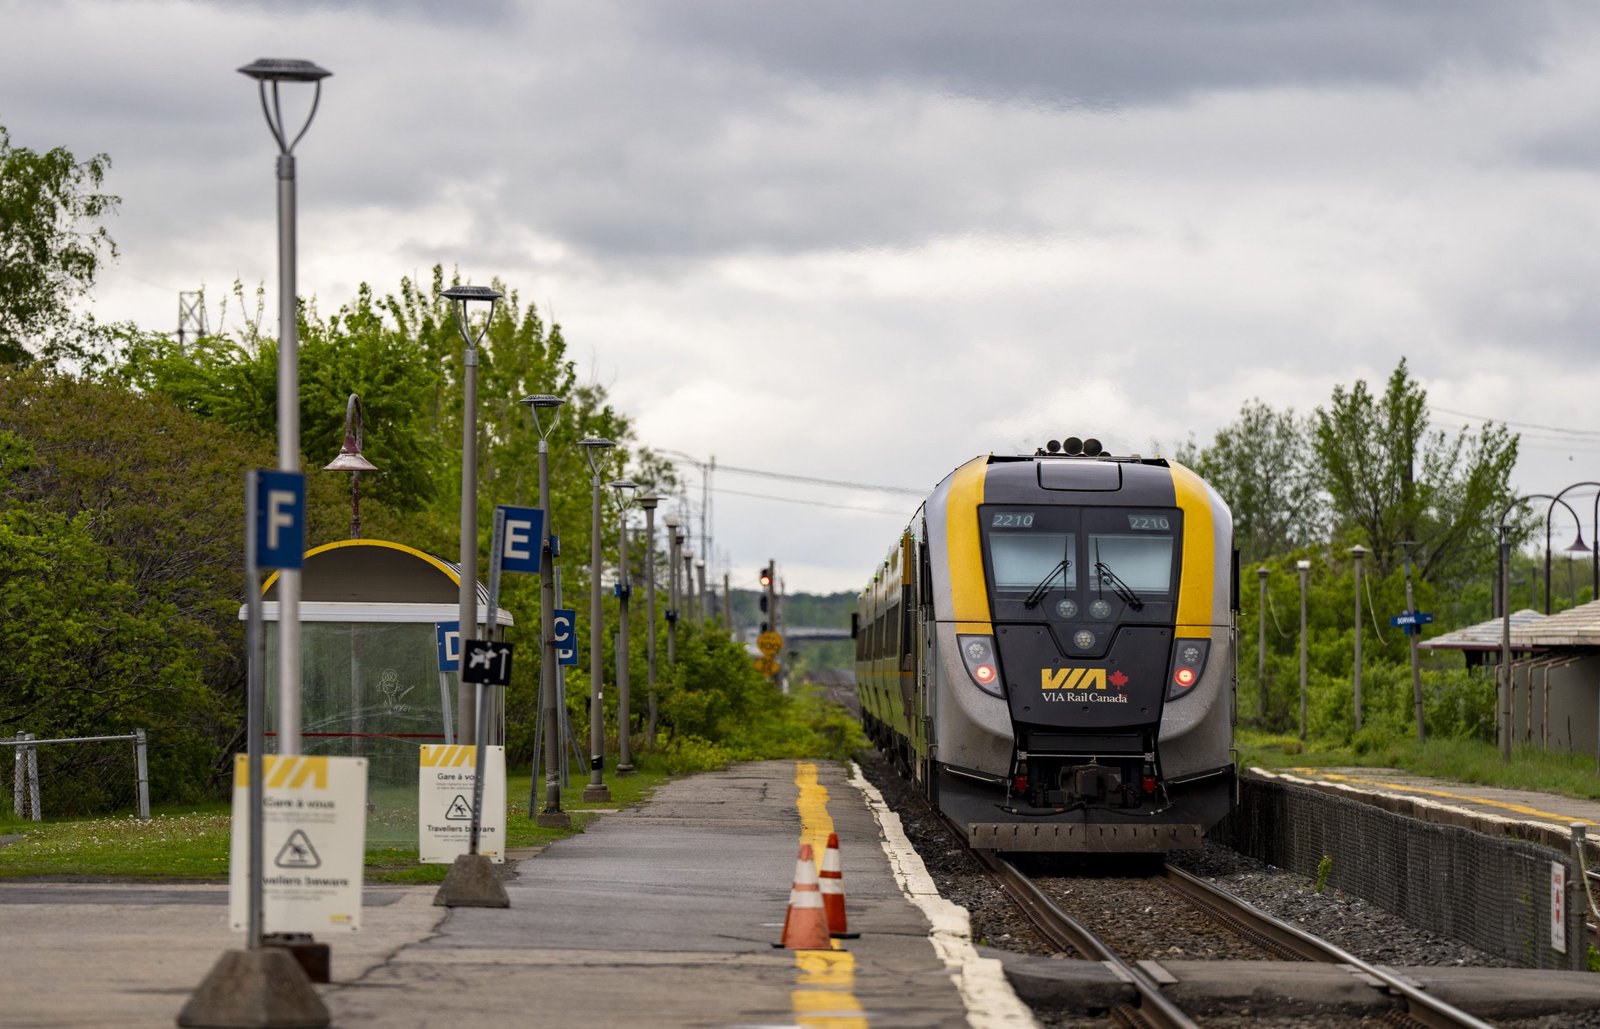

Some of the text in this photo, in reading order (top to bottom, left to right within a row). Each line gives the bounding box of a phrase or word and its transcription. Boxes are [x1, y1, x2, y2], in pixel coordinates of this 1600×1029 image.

[267, 490, 296, 550] F
[993, 515, 1033, 526] 2210
[1130, 517, 1170, 529] 2210
[504, 519, 532, 560] E
[554, 617, 570, 642] C
[1041, 668, 1107, 690] VIA
[1042, 692, 1128, 703] VIA Rail Canada
[420, 746, 477, 768] VIA
[427, 825, 463, 833] Travellers
